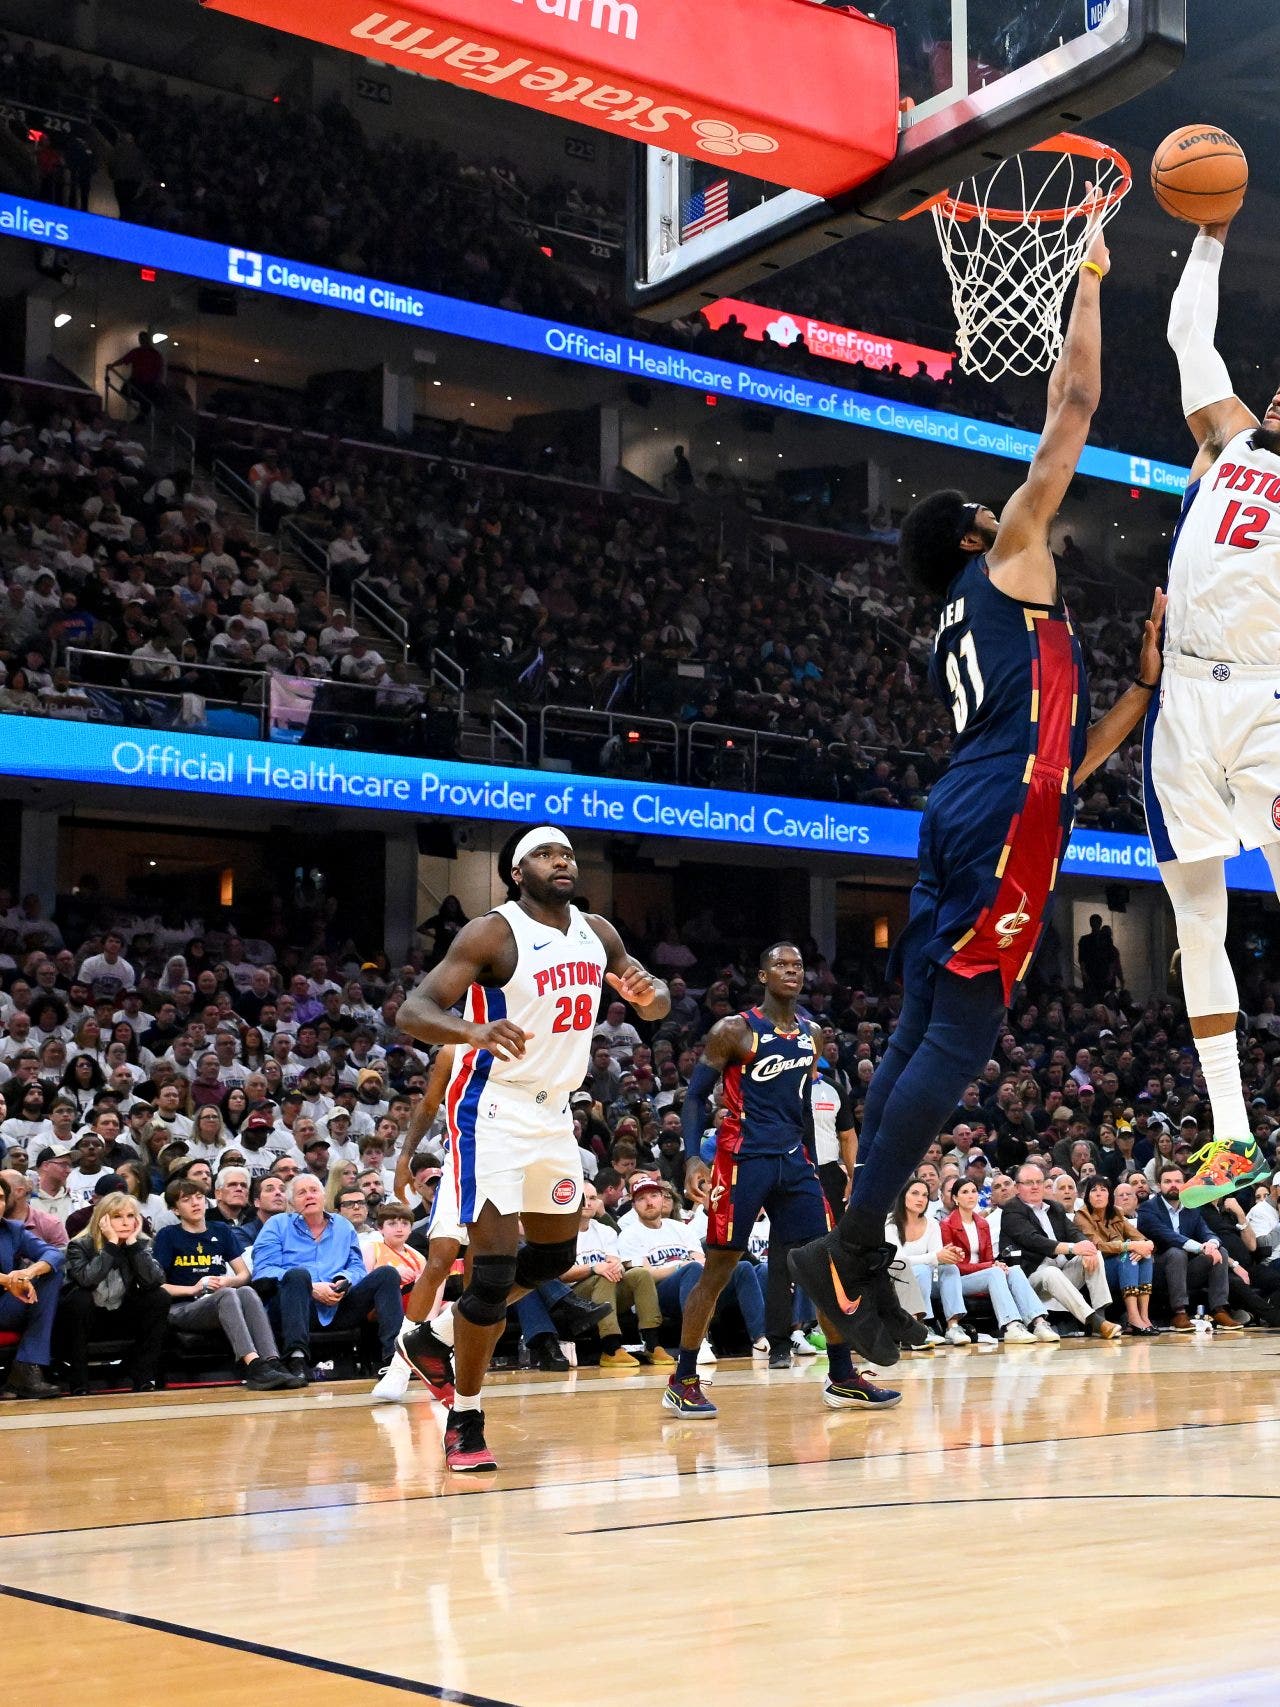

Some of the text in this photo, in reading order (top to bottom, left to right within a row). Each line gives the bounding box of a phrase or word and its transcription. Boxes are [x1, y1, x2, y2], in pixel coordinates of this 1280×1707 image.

[267, 264, 423, 317] Cleveland Clinic
[807, 321, 893, 359] ForeFront
[545, 328, 1036, 457] Official Healthcare Provider of the Cleveland Cavaliers
[1153, 468, 1189, 488] Clevel
[1215, 500, 1270, 549] 12
[112, 741, 869, 844] Official Healthcare Provider of the Cleveland Cavaliers
[533, 961, 602, 997] PISTONS
[552, 994, 592, 1033] 28
